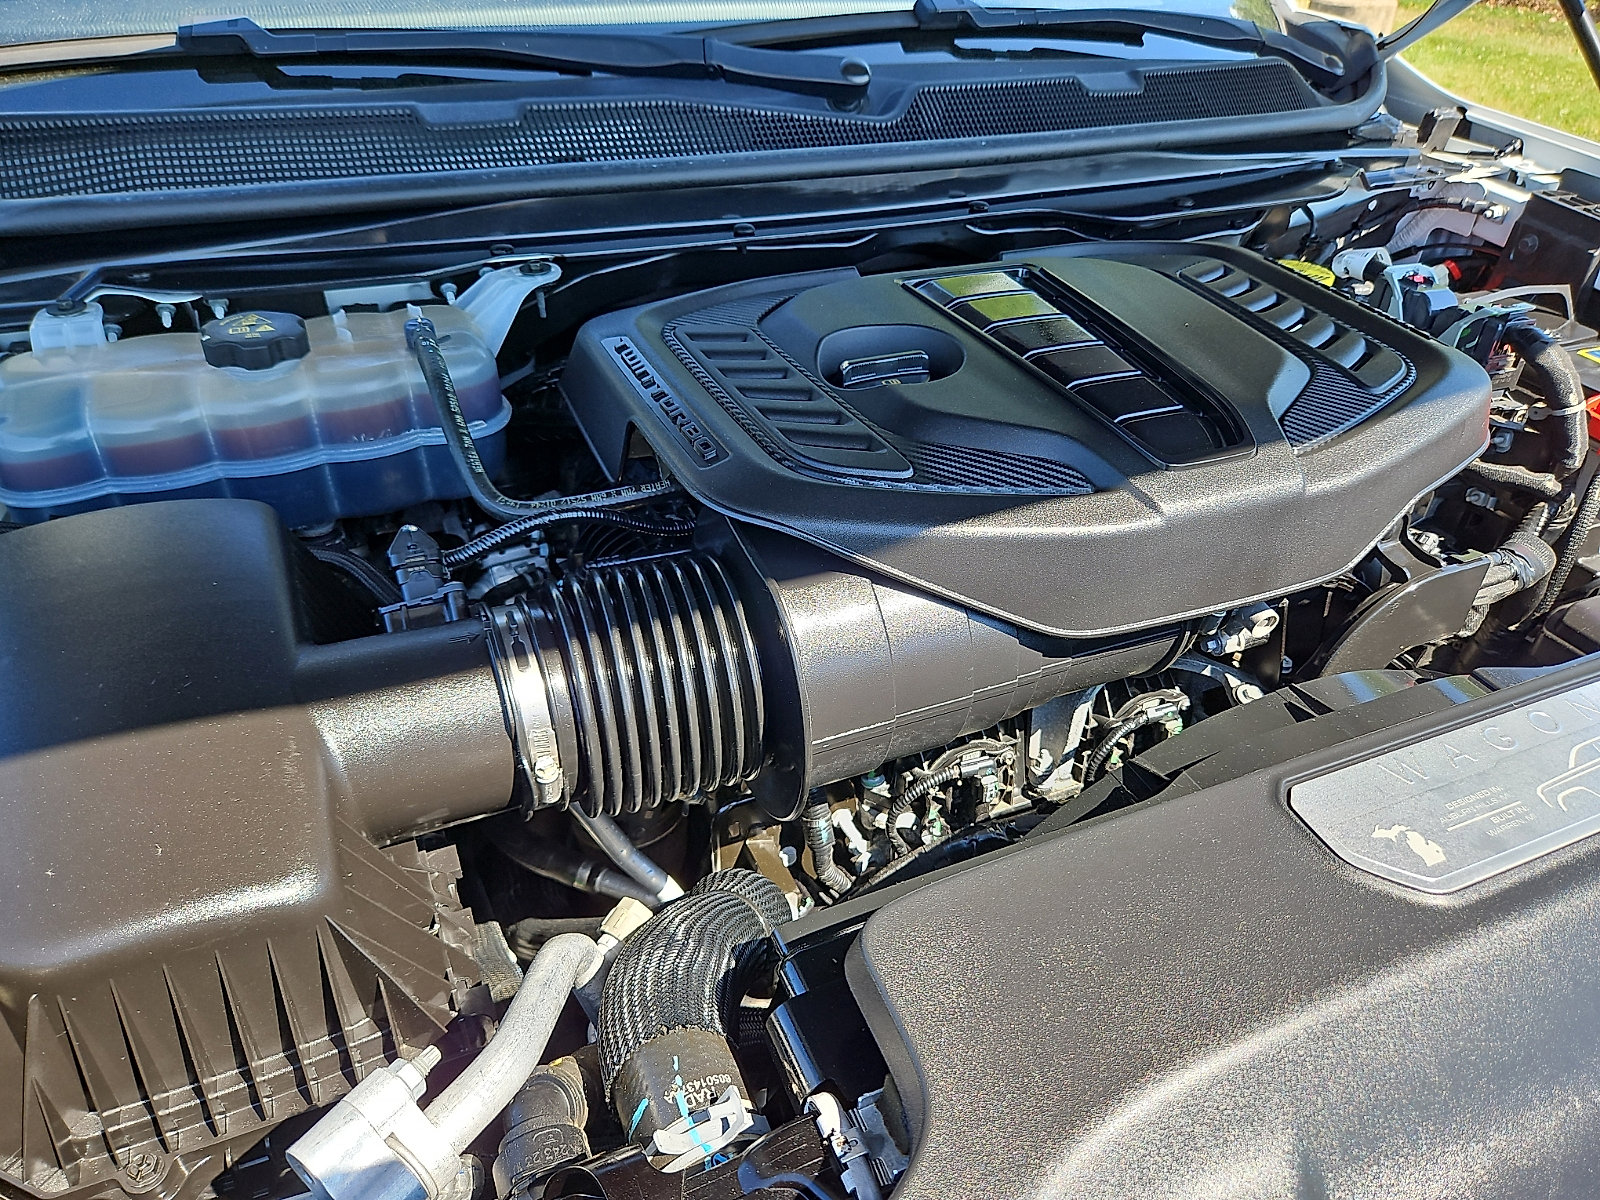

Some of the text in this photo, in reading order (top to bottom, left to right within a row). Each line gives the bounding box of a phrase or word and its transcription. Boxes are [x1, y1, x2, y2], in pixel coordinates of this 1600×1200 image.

[614, 338, 718, 460] TWIN TURBO
[620, 485, 637, 498] 7MM
[640, 479, 671, 494] HEATER
[591, 492, 607, 502] 6MM
[1444, 788, 1491, 810] DESIGNED
[1490, 809, 1516, 824] BUILT
[685, 1086, 717, 1108] RAD
